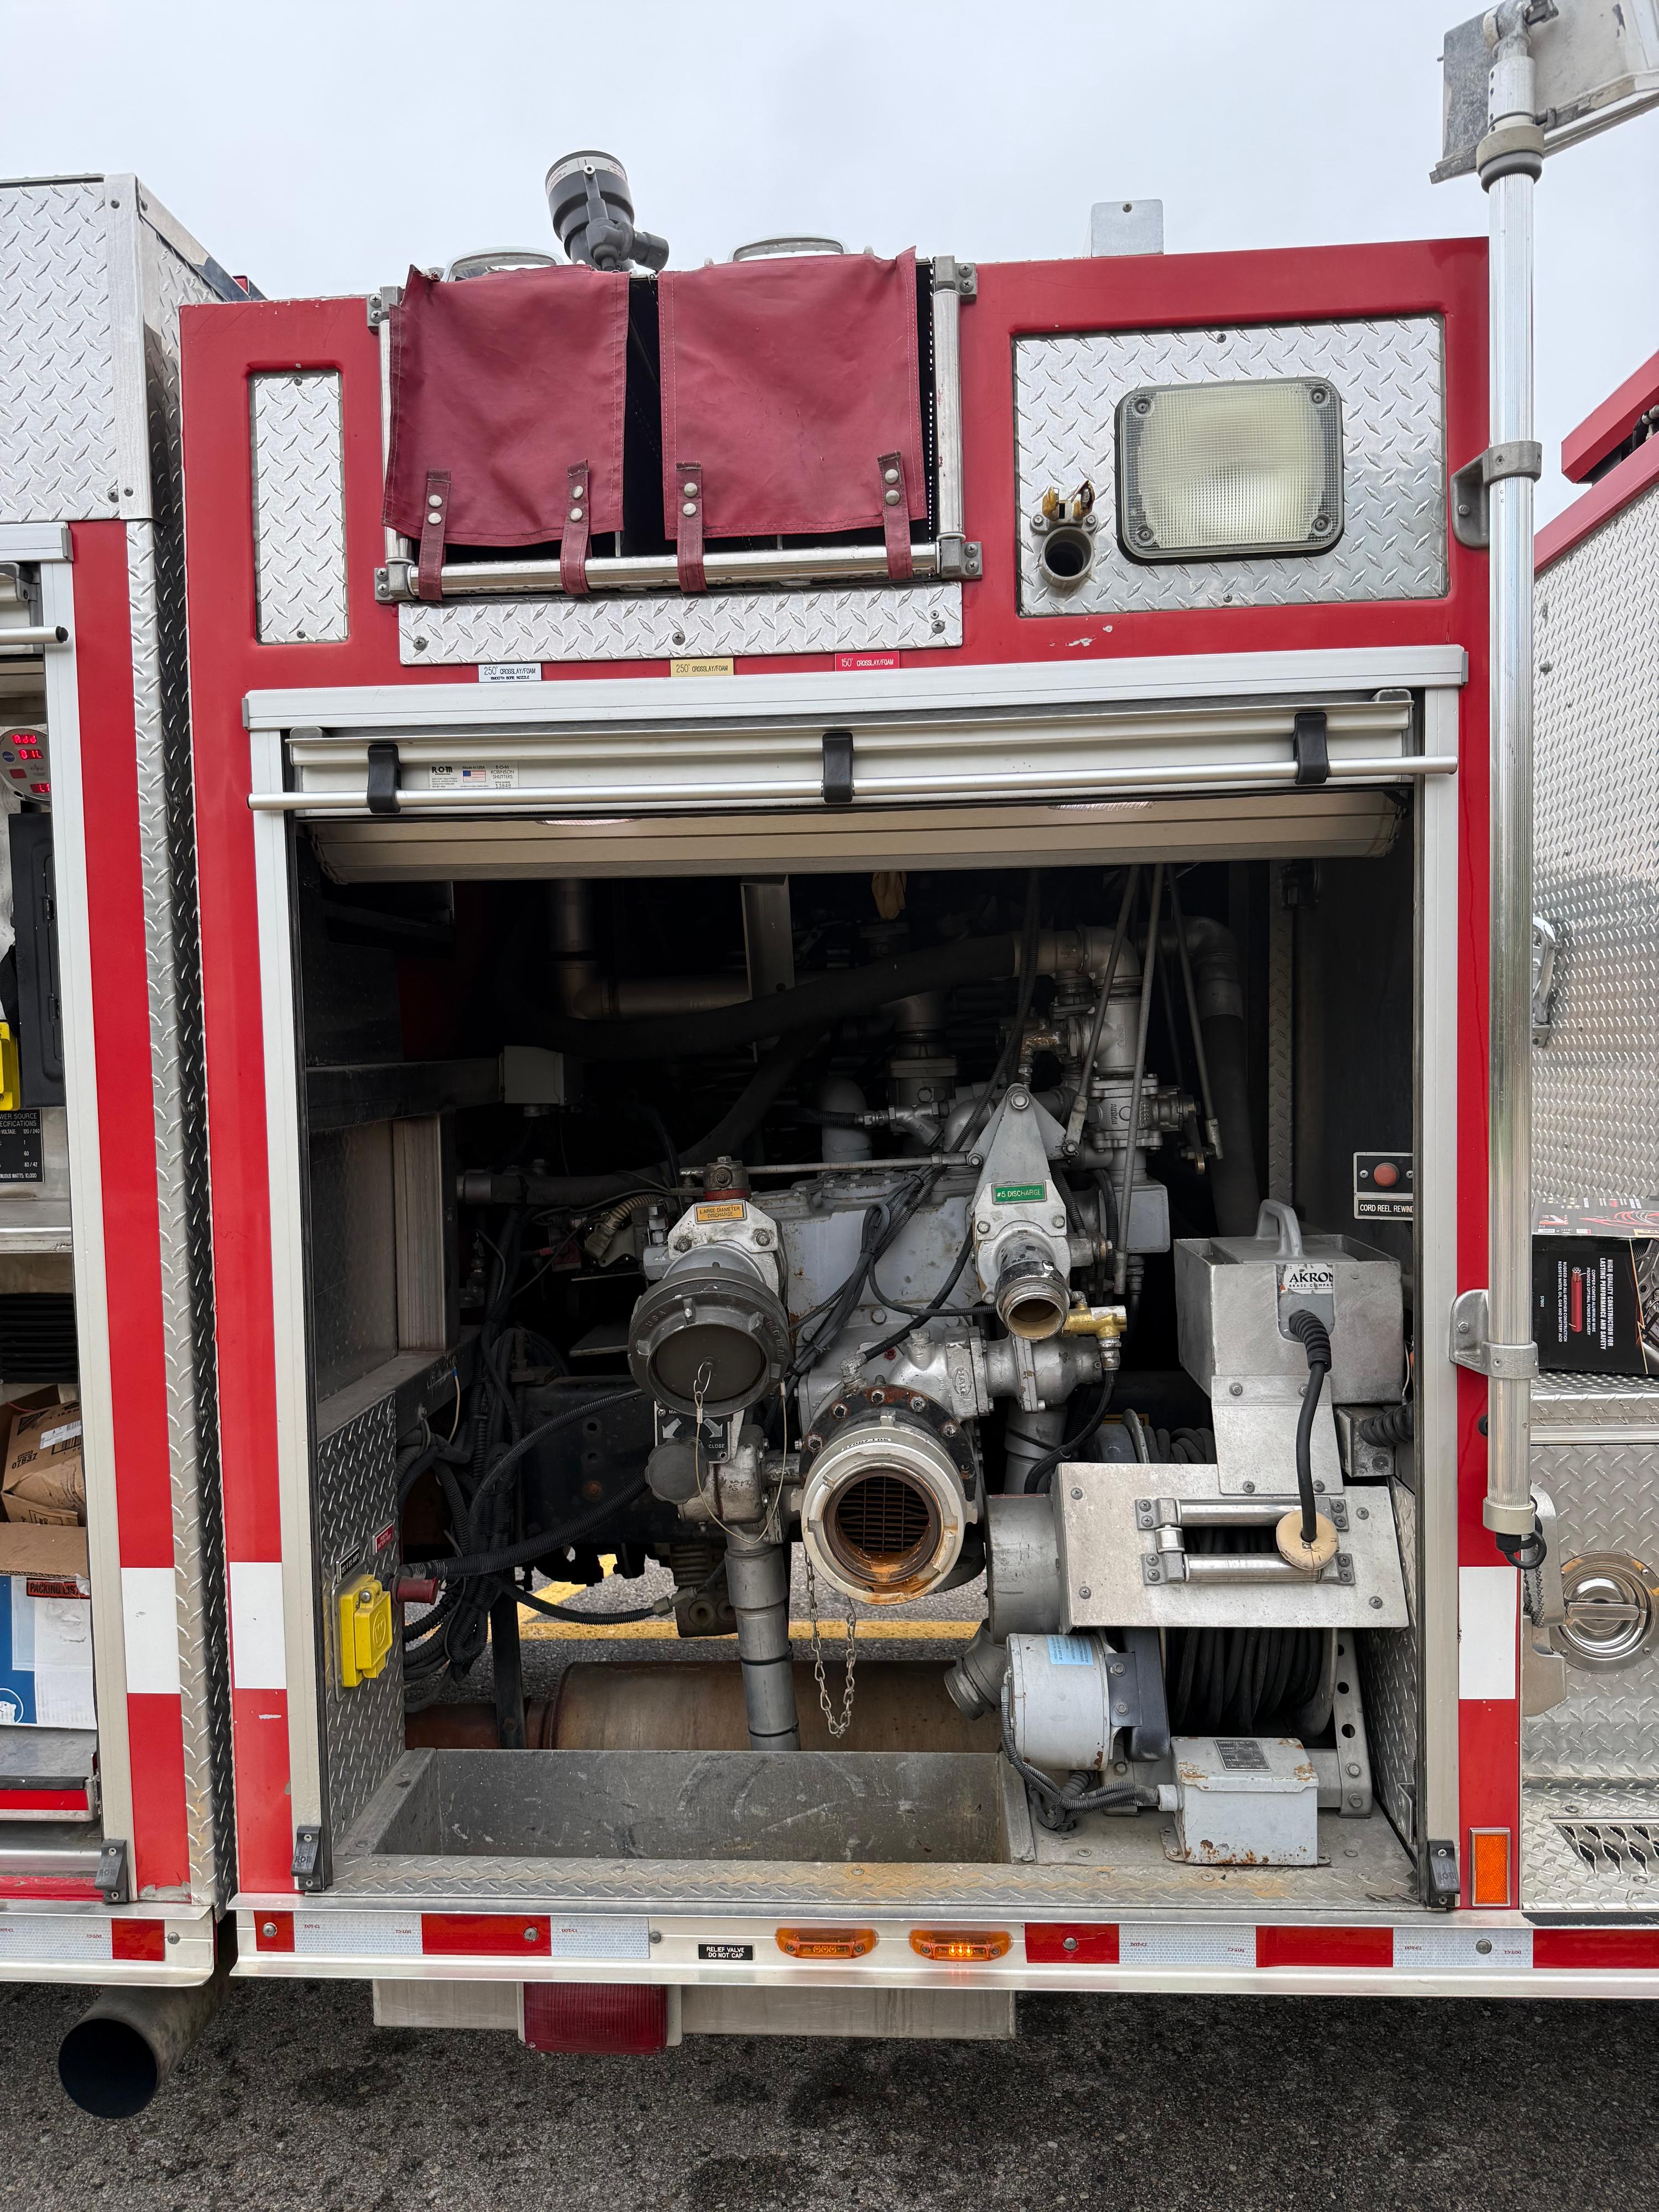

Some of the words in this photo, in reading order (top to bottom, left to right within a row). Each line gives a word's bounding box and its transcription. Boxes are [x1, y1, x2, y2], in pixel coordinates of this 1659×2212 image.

[484, 666, 498, 675] 250'
[676, 664, 690, 673] 250'
[1008, 1189, 1041, 1197] DISCHARGE
[29, 1583, 62, 1594] PACKING
[63, 1584, 79, 1595] LIS
